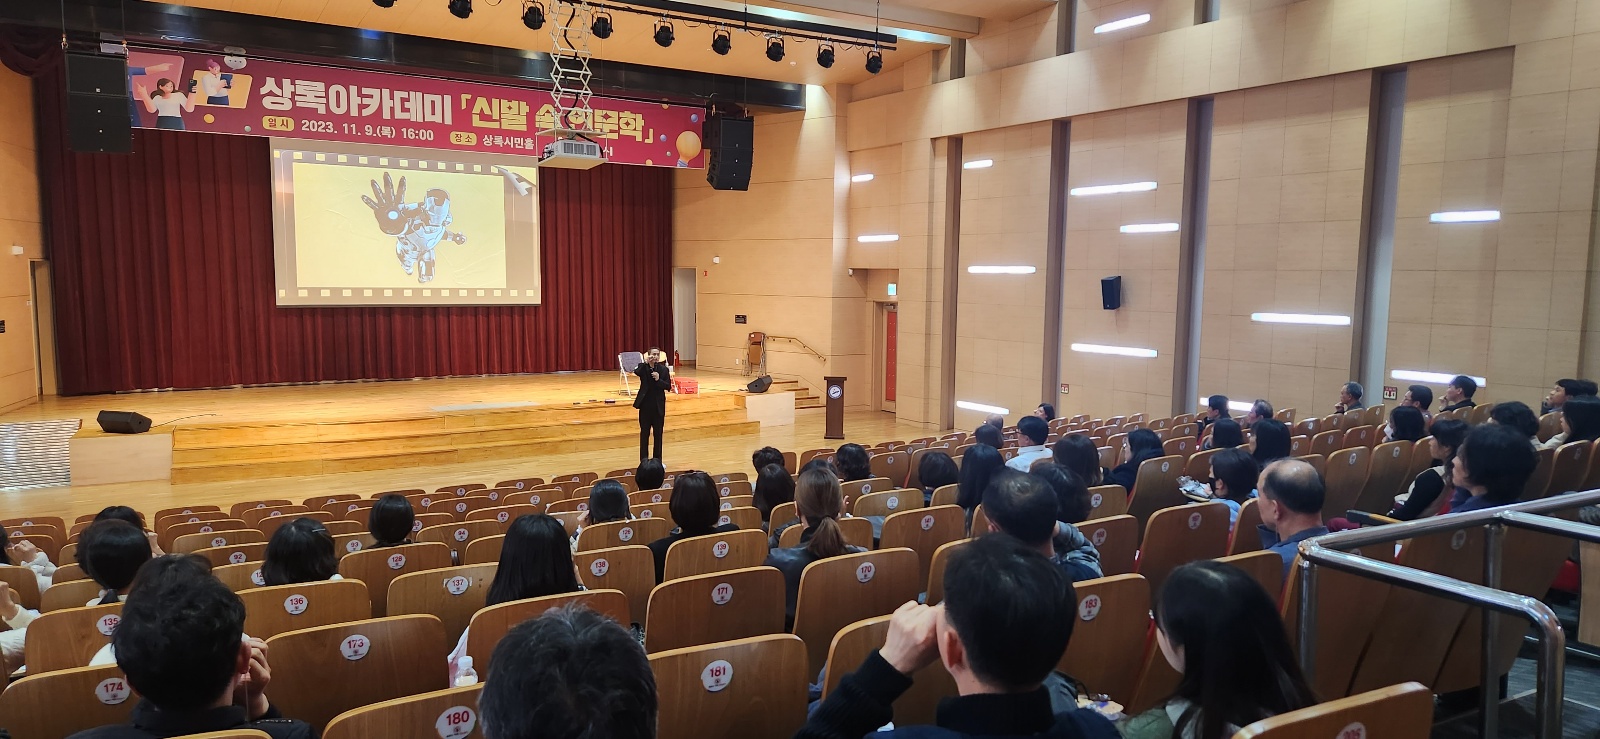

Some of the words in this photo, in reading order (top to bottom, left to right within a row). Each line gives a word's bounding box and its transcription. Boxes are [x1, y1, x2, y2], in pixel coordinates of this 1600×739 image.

[259, 76, 453, 125] 상록아카데미
[301, 119, 338, 133] 2023.
[342, 123, 361, 135] 11.
[401, 128, 434, 140] 16:00
[482, 134, 534, 149] 상록시민홀
[452, 579, 464, 587] 137
[717, 586, 728, 594] 171
[289, 597, 304, 606] 136
[1085, 598, 1098, 609] 183
[103, 618, 119, 626] 135
[347, 639, 364, 649] 173
[710, 666, 726, 678] 181
[104, 681, 124, 693] 174
[446, 710, 470, 726] 180
